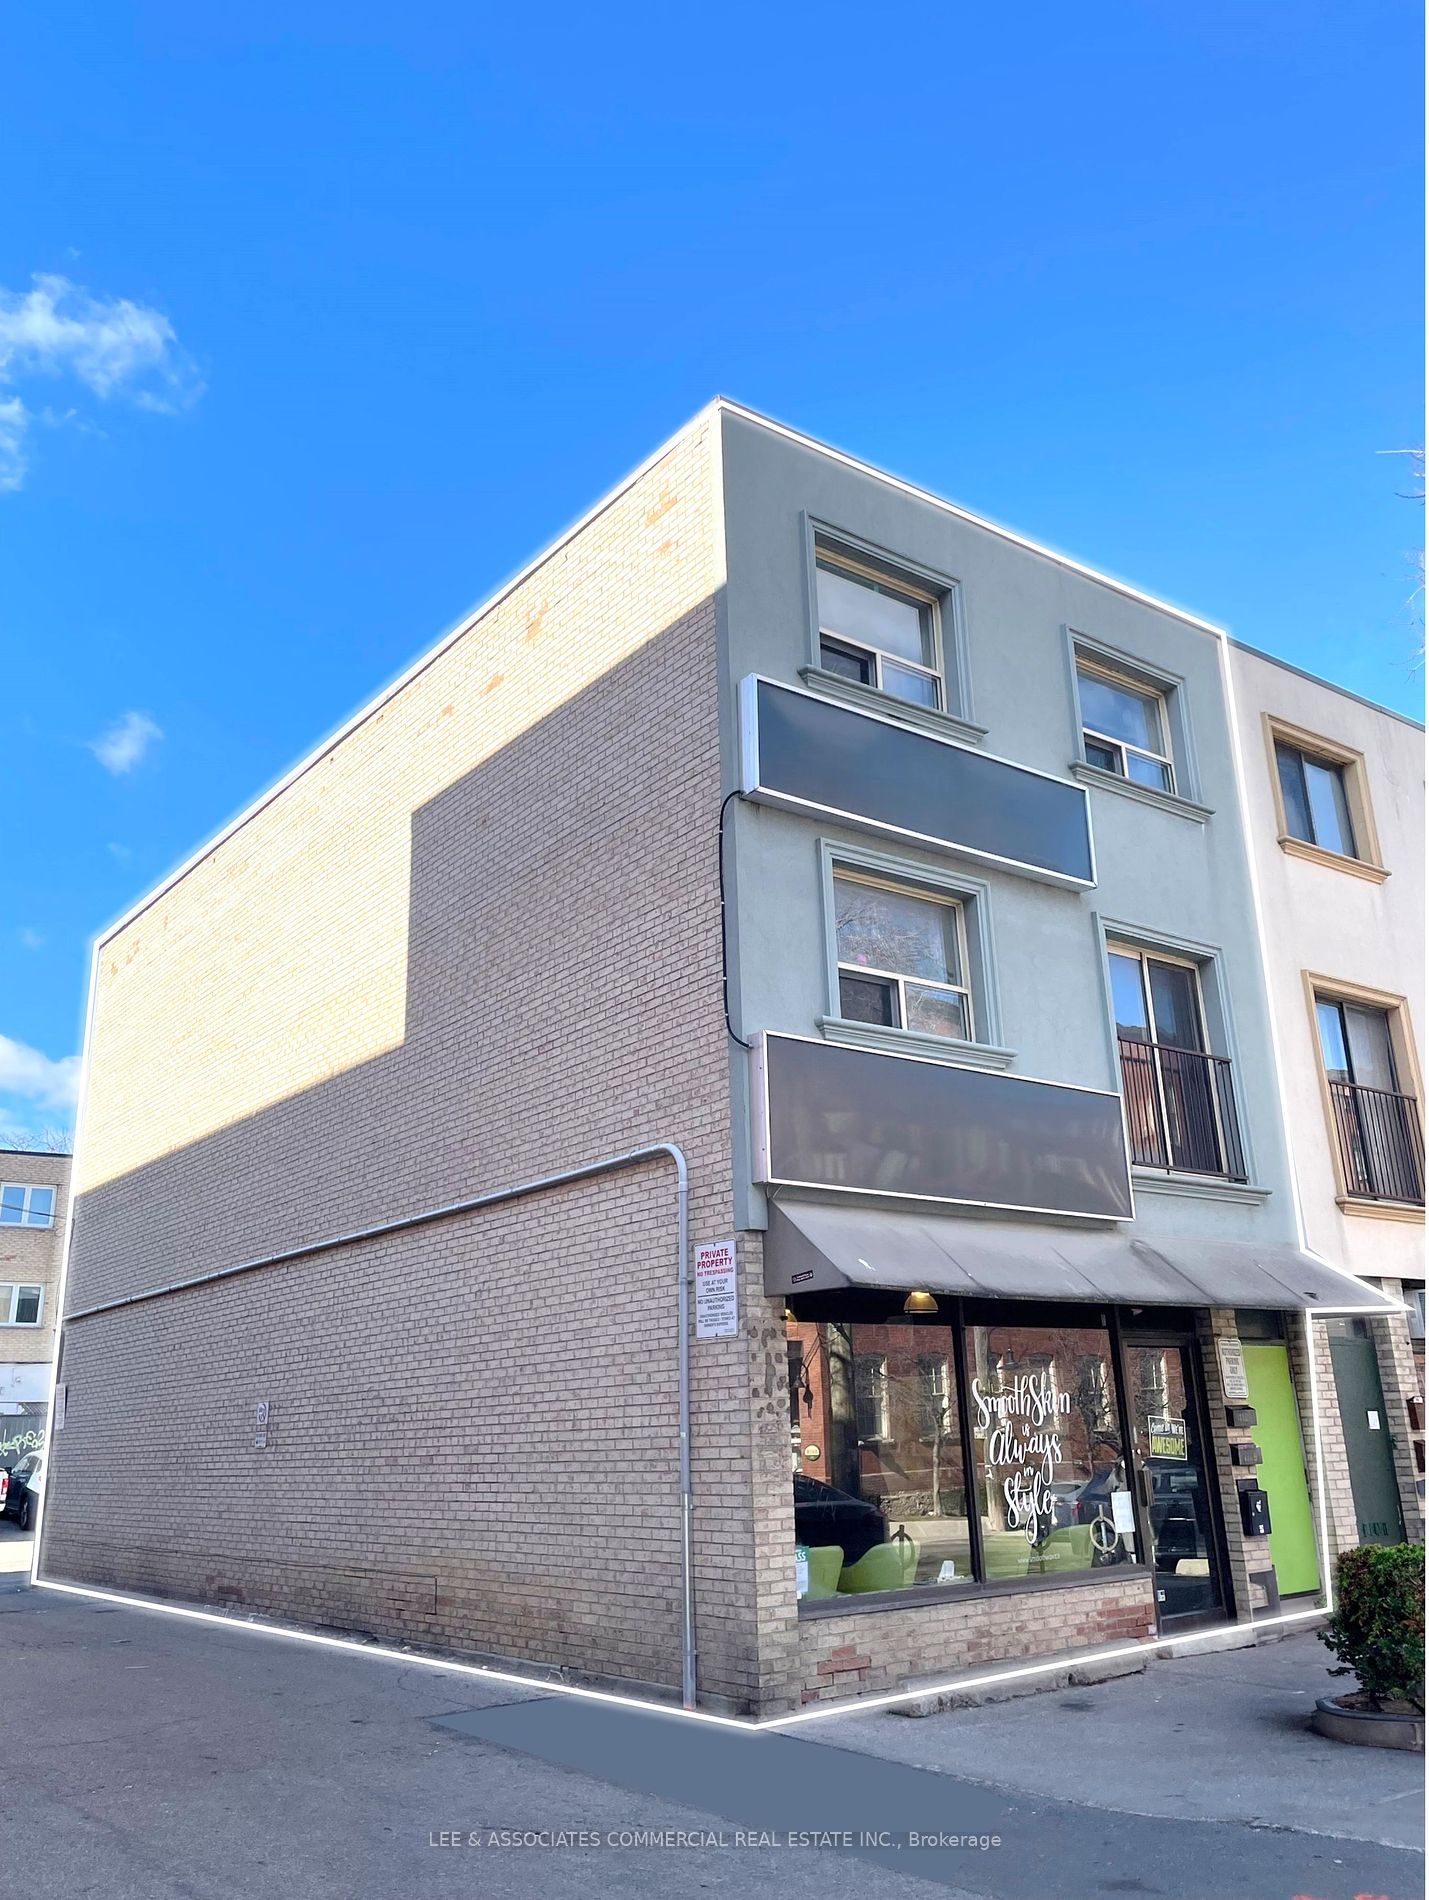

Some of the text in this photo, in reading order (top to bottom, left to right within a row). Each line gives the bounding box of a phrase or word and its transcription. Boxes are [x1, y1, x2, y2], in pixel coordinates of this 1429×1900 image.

[701, 1248, 729, 1260] PRIVATE
[697, 1257, 733, 1269] PROPERTY
[704, 1267, 734, 1275] TRESPASSING
[972, 1372, 1070, 1430] Smooth Skin
[1022, 1423, 1030, 1435] is
[1152, 1436, 1184, 1455] AWESOME
[1024, 1465, 1033, 1476] in
[1004, 1472, 1053, 1544] Style
